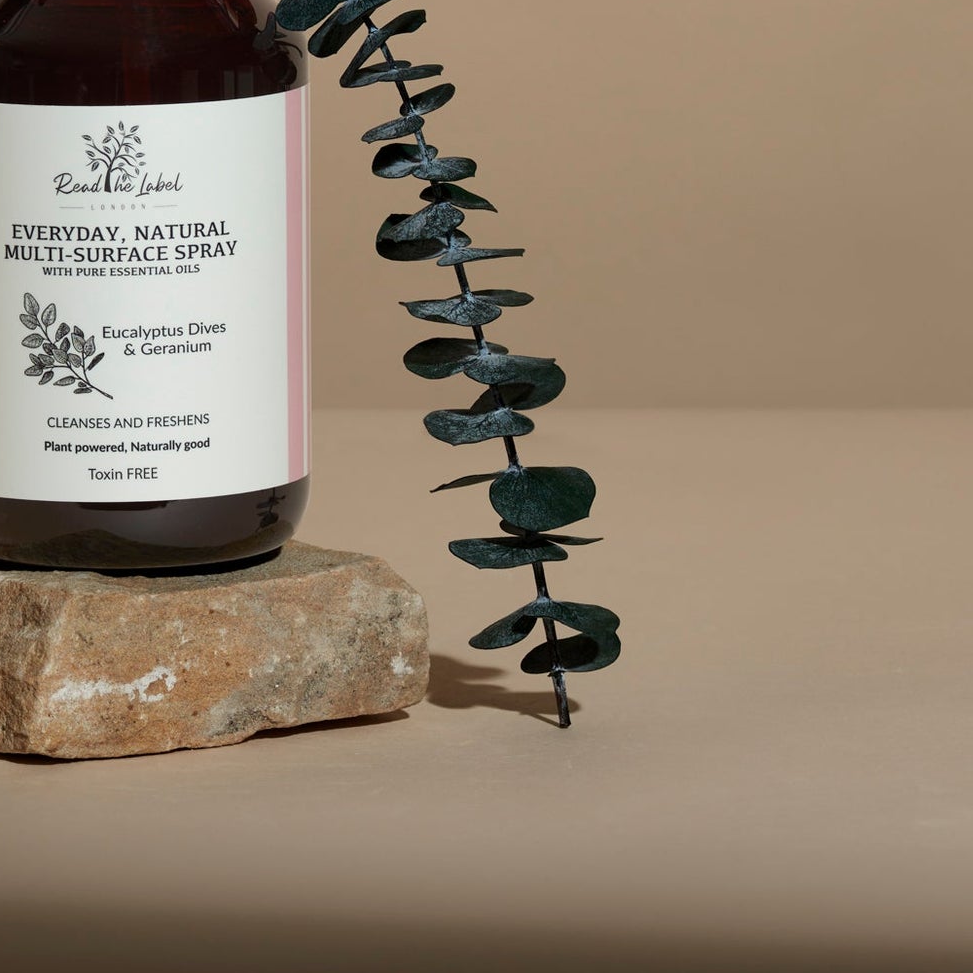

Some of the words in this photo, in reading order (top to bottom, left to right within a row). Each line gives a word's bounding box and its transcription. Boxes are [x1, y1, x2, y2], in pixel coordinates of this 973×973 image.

[53, 172, 103, 196] Read
[135, 172, 184, 198] Label
[90, 203, 147, 211] LONDON
[11, 223, 127, 244] EVERYDAY,
[134, 220, 230, 241] NATURAL
[4, 244, 169, 263] MULTI-SURFACE
[174, 240, 238, 260] SPRAY
[42, 266, 73, 276] WITH
[76, 267, 107, 277] PURE
[110, 266, 173, 277] ESSENTIAL
[175, 264, 201, 275] OILS
[102, 325, 184, 341] Eucalyptus
[188, 322, 227, 338] Dives
[123, 343, 137, 356] &
[140, 341, 212, 356] Geranium
[47, 416, 111, 429] CLEANSES
[114, 417, 144, 429] AND
[146, 413, 210, 429] FRESHENS
[44, 440, 73, 453] Plant
[75, 442, 128, 454] powered,
[130, 439, 182, 453] Naturally
[184, 437, 211, 452] good
[88, 467, 123, 481] Toxin
[126, 467, 159, 481] FREE
